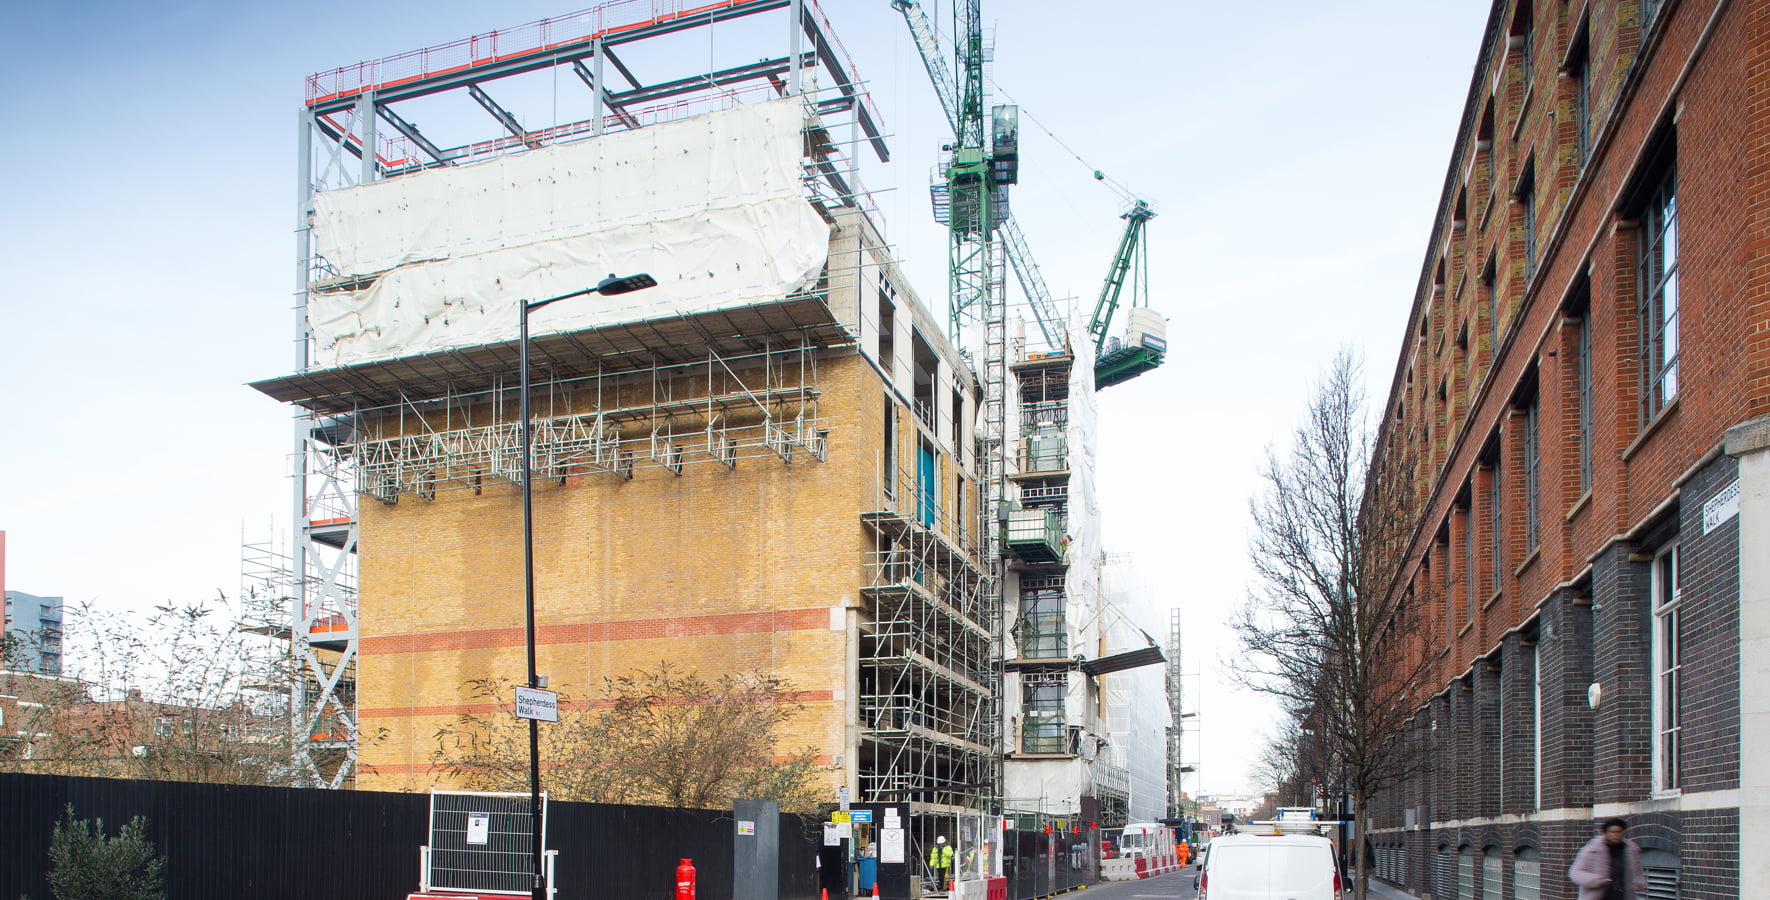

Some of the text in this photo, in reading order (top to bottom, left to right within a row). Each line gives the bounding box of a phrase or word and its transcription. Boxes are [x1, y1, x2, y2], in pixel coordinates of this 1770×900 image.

[1706, 510, 1719, 529] WALK
[518, 695, 555, 708] Shepherdess
[518, 705, 533, 715] Walk
